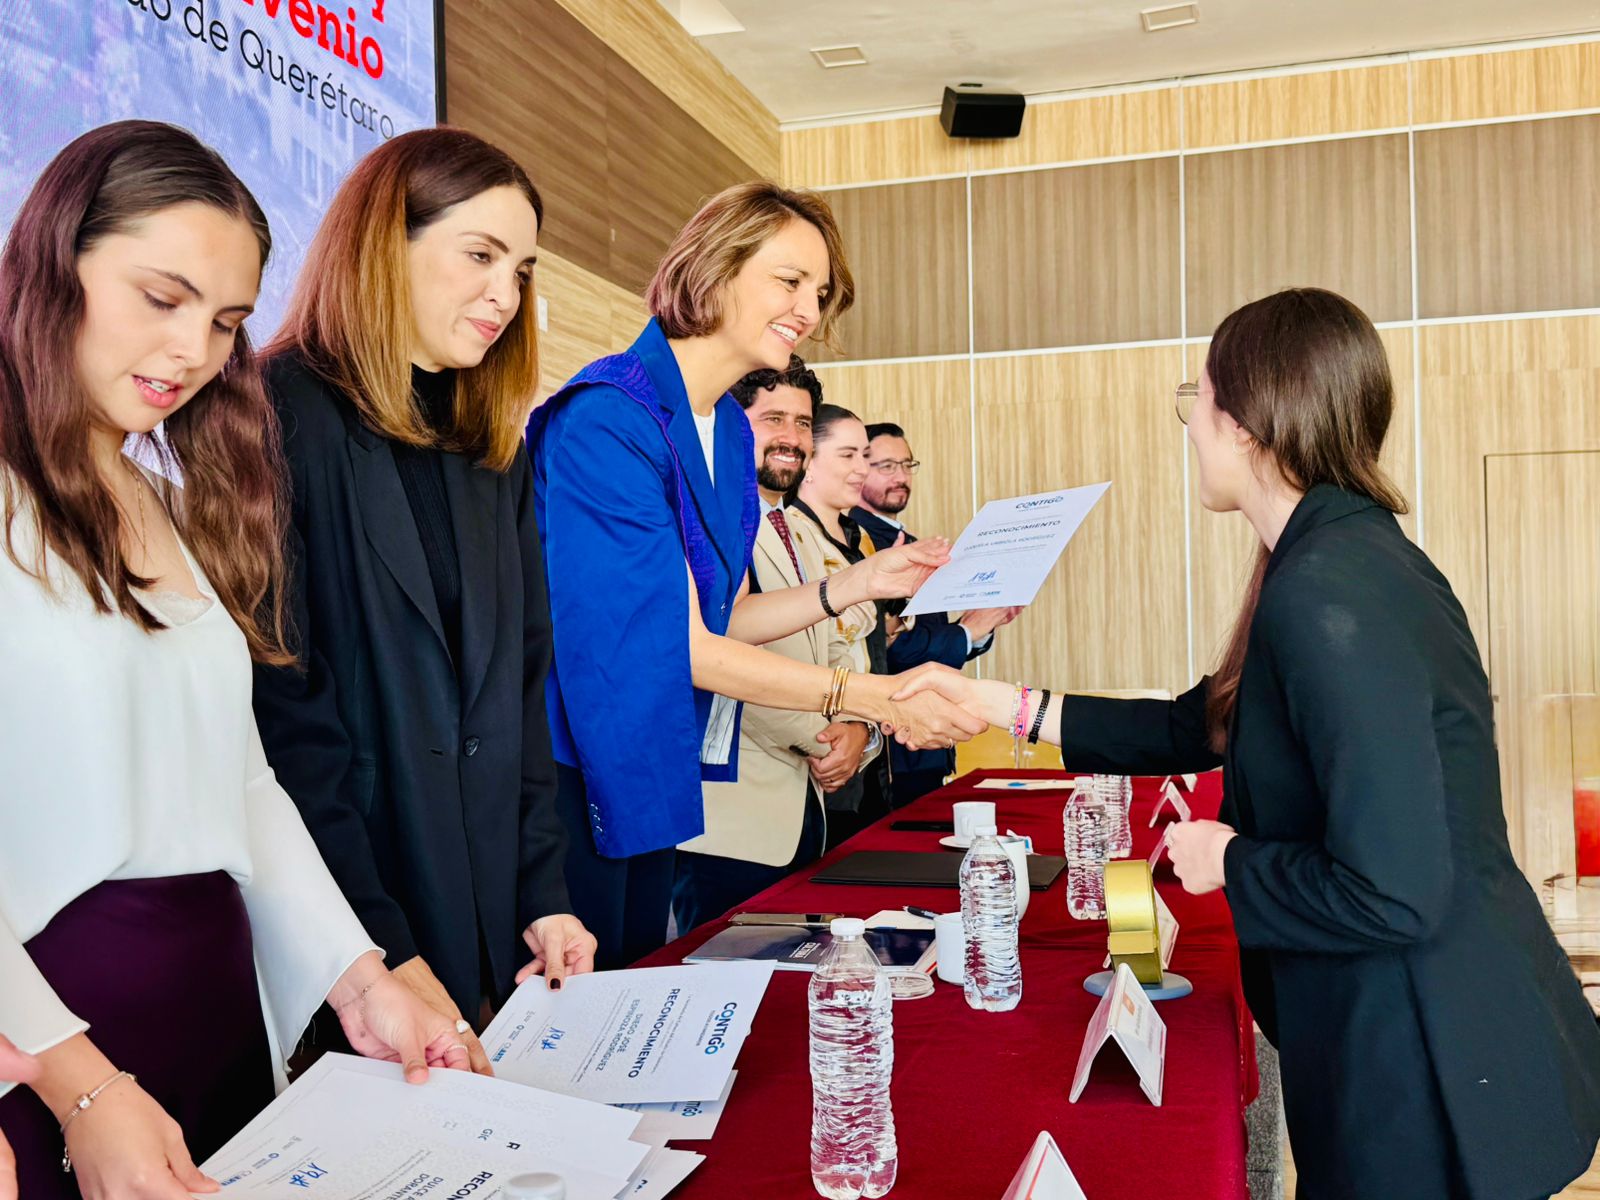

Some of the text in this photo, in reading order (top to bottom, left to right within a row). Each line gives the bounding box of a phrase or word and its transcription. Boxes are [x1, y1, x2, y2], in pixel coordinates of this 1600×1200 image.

[183, 0, 228, 51] de
[240, 29, 394, 139] Querétaro
[1015, 495, 1064, 509] CONTIGO
[977, 520, 1061, 537] RECONOCIMIENTO
[627, 988, 681, 1079] RECONOCIMIENTO
[704, 1002, 738, 1055] CONTIGO
[412, 1176, 444, 1197] DULCE
